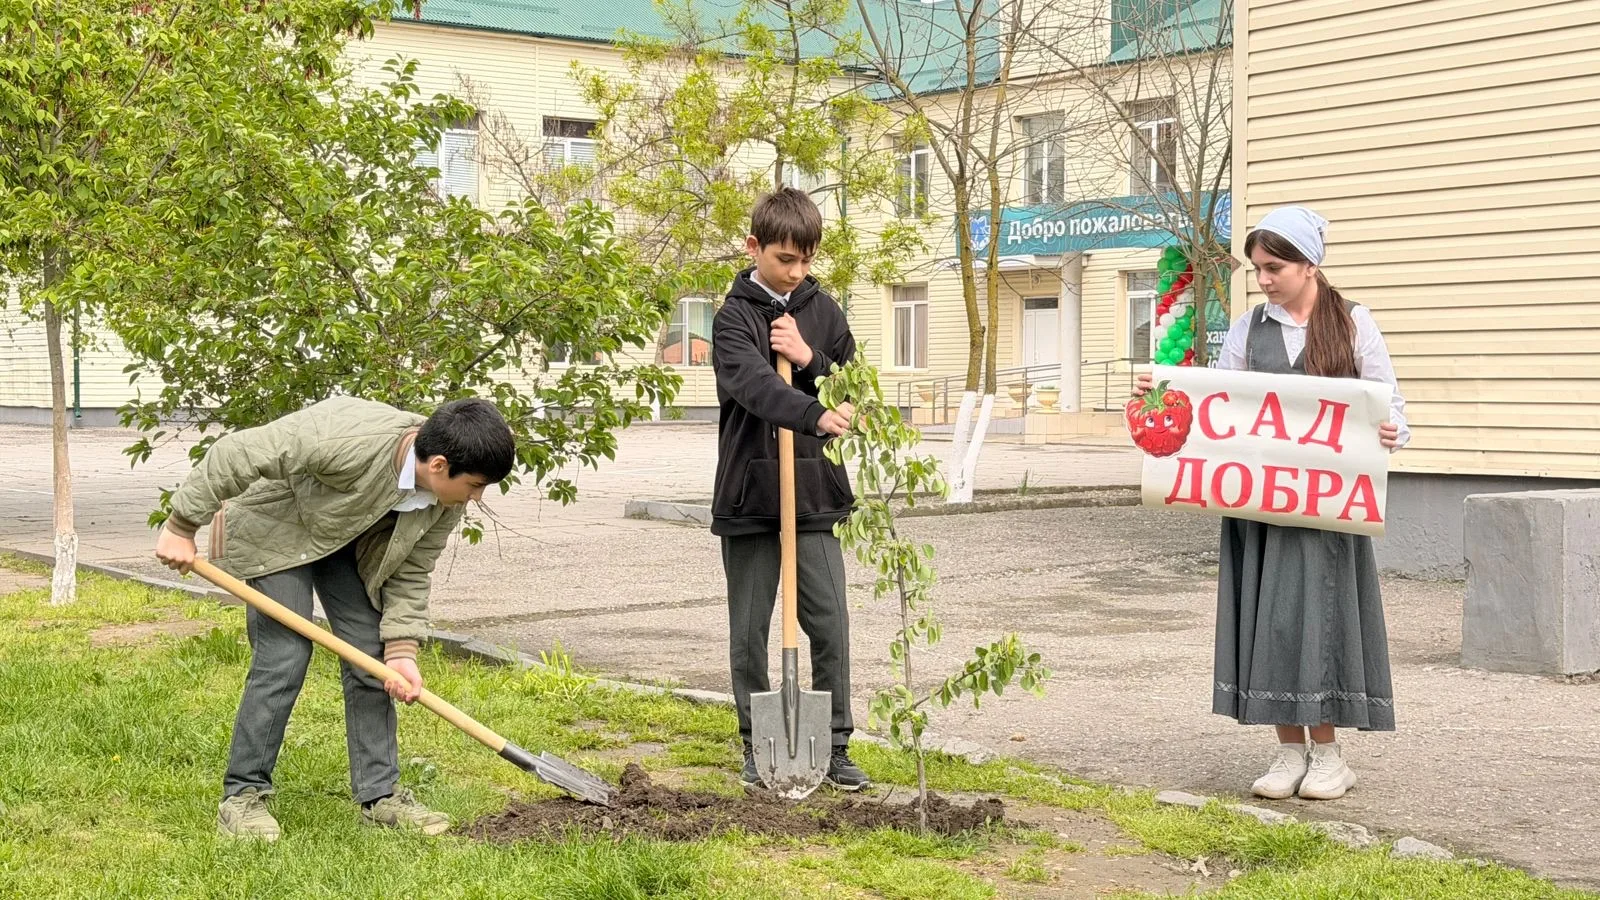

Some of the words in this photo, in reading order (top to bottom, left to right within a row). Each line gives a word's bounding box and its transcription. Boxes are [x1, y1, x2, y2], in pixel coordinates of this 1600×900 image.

[1008, 217, 1066, 245] Добро
[1069, 211, 1194, 236] пожаловать
[1198, 391, 1350, 454] САД
[1164, 457, 1384, 523] ДОБРА
